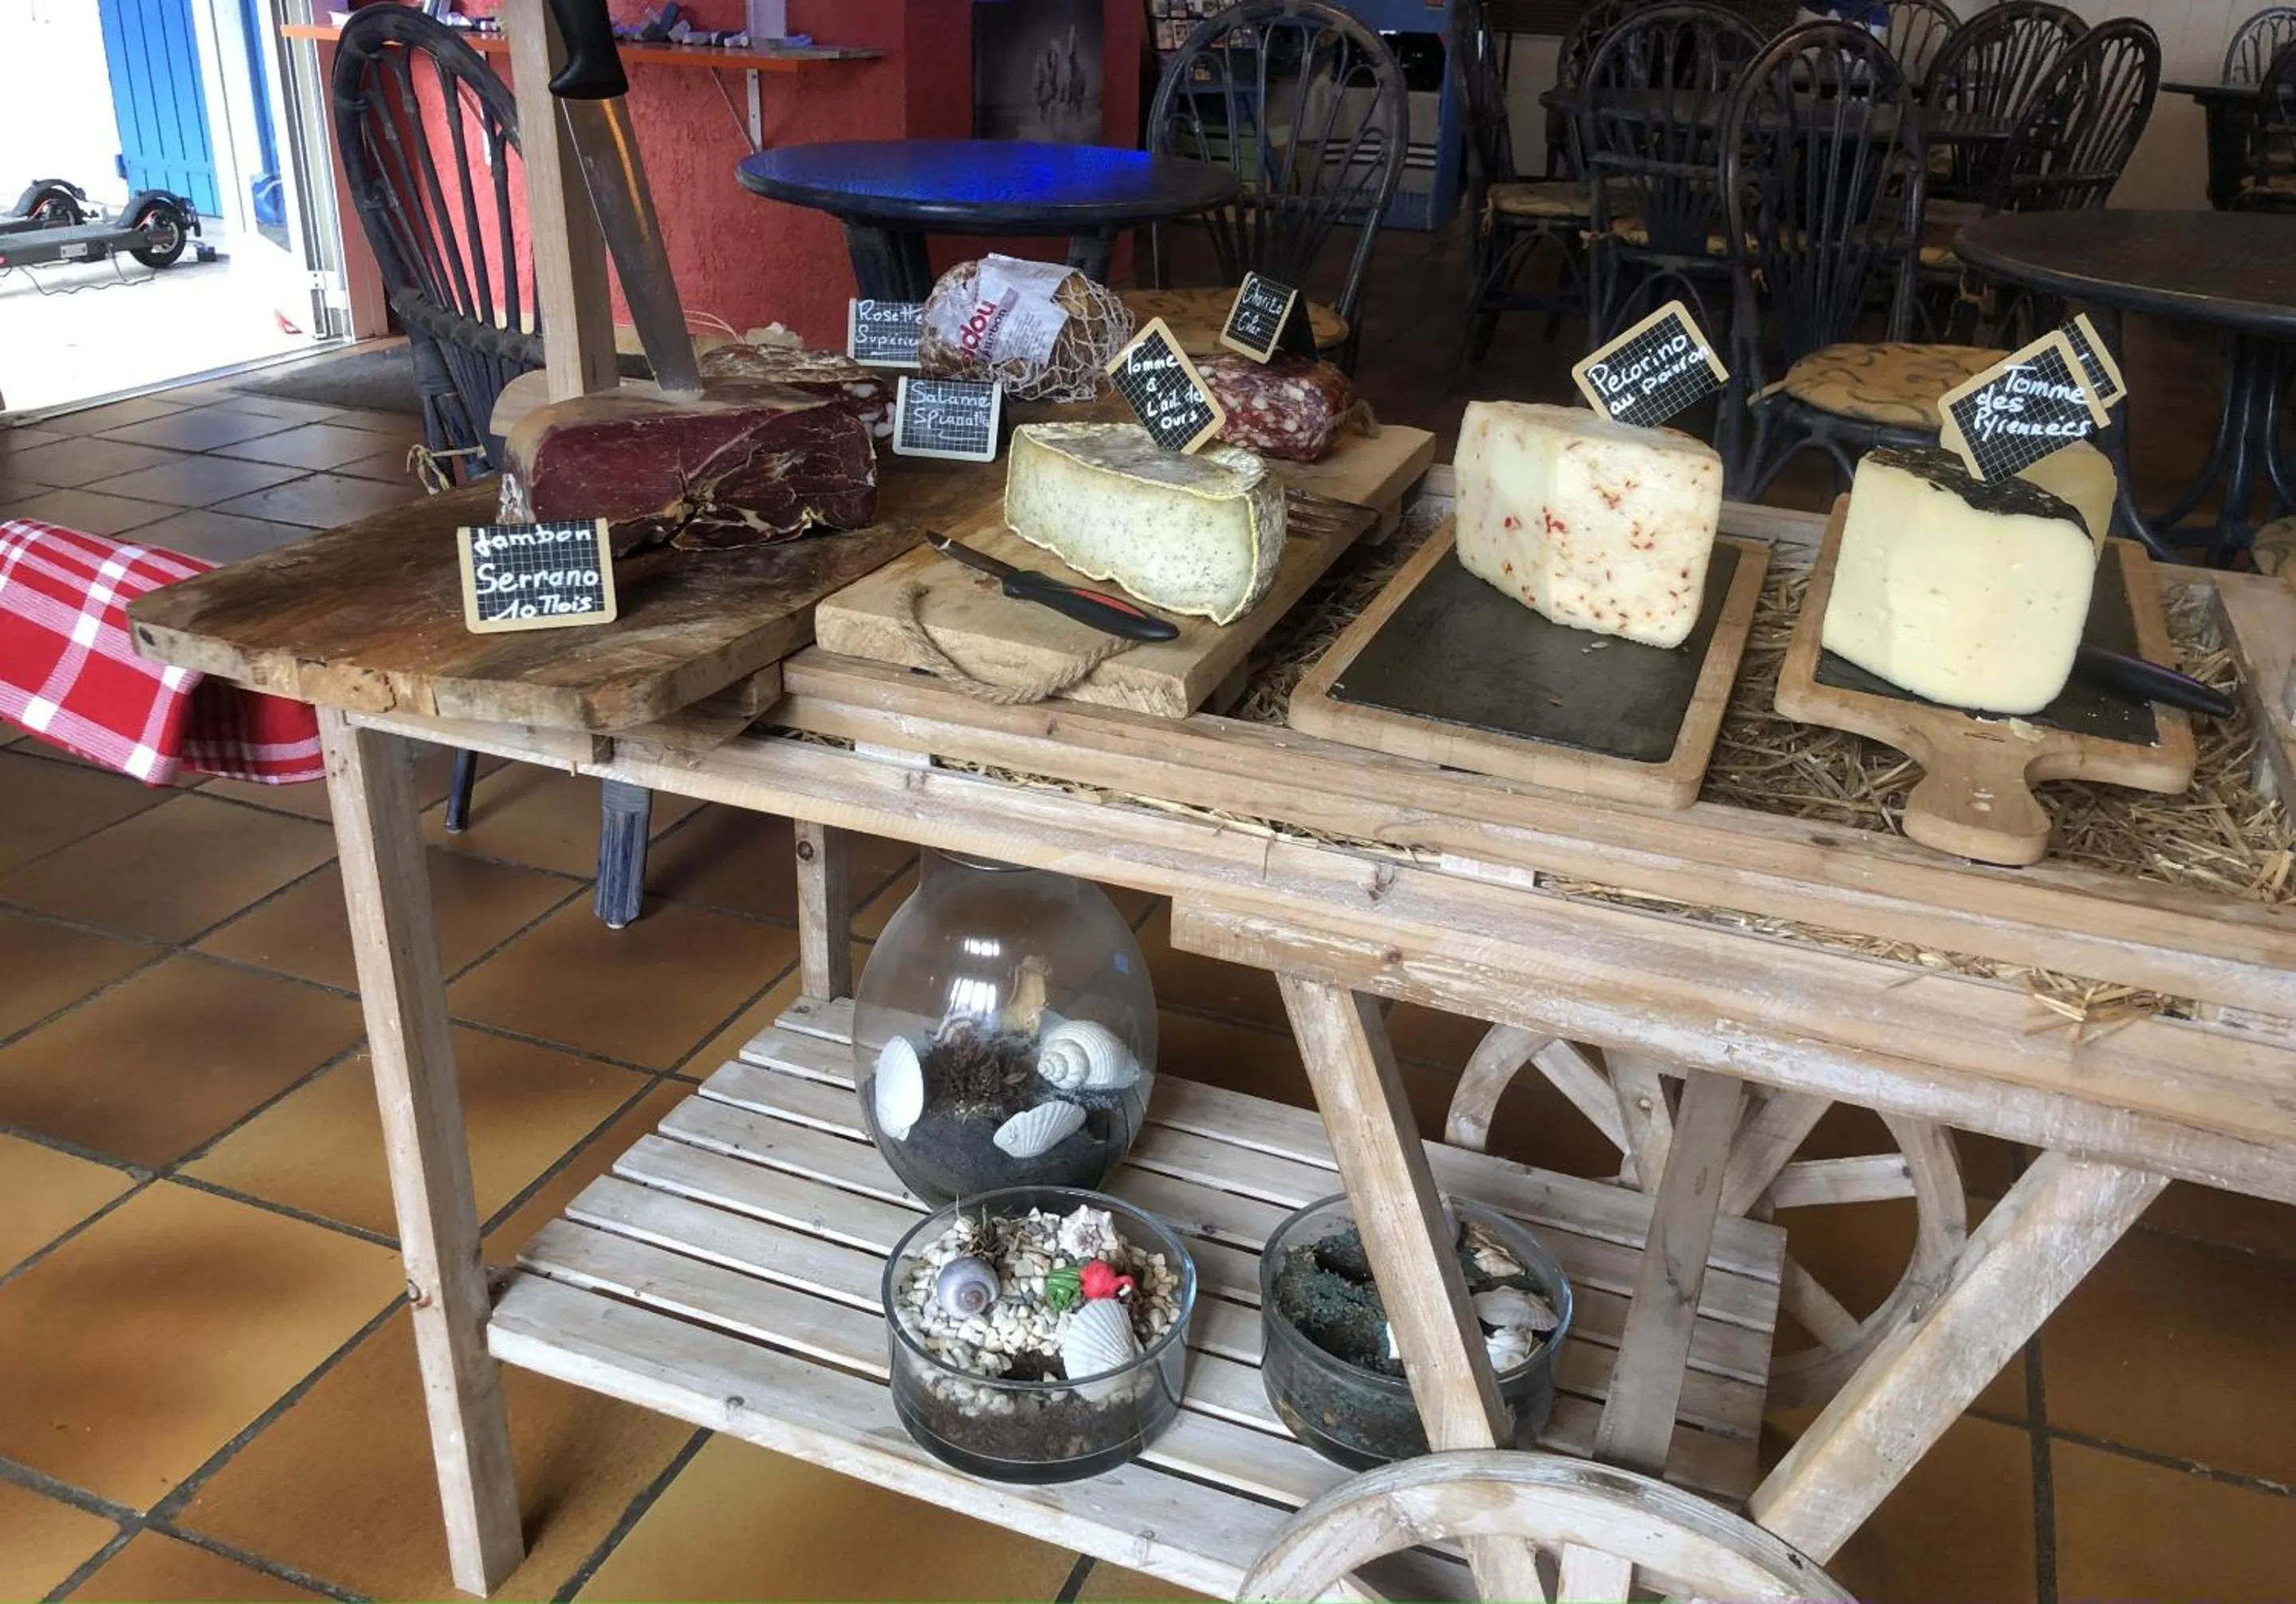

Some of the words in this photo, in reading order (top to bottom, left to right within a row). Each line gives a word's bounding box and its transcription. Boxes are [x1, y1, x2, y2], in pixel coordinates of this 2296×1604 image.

[1122, 342, 1180, 375] Tomme
[1587, 335, 1687, 396] Pecorino
[1975, 384, 2024, 412] des
[2003, 364, 2090, 404] Tomme
[1610, 393, 1636, 415] au
[474, 524, 591, 557] Jambon
[477, 563, 599, 594] Serrano
[488, 600, 537, 622] 10
